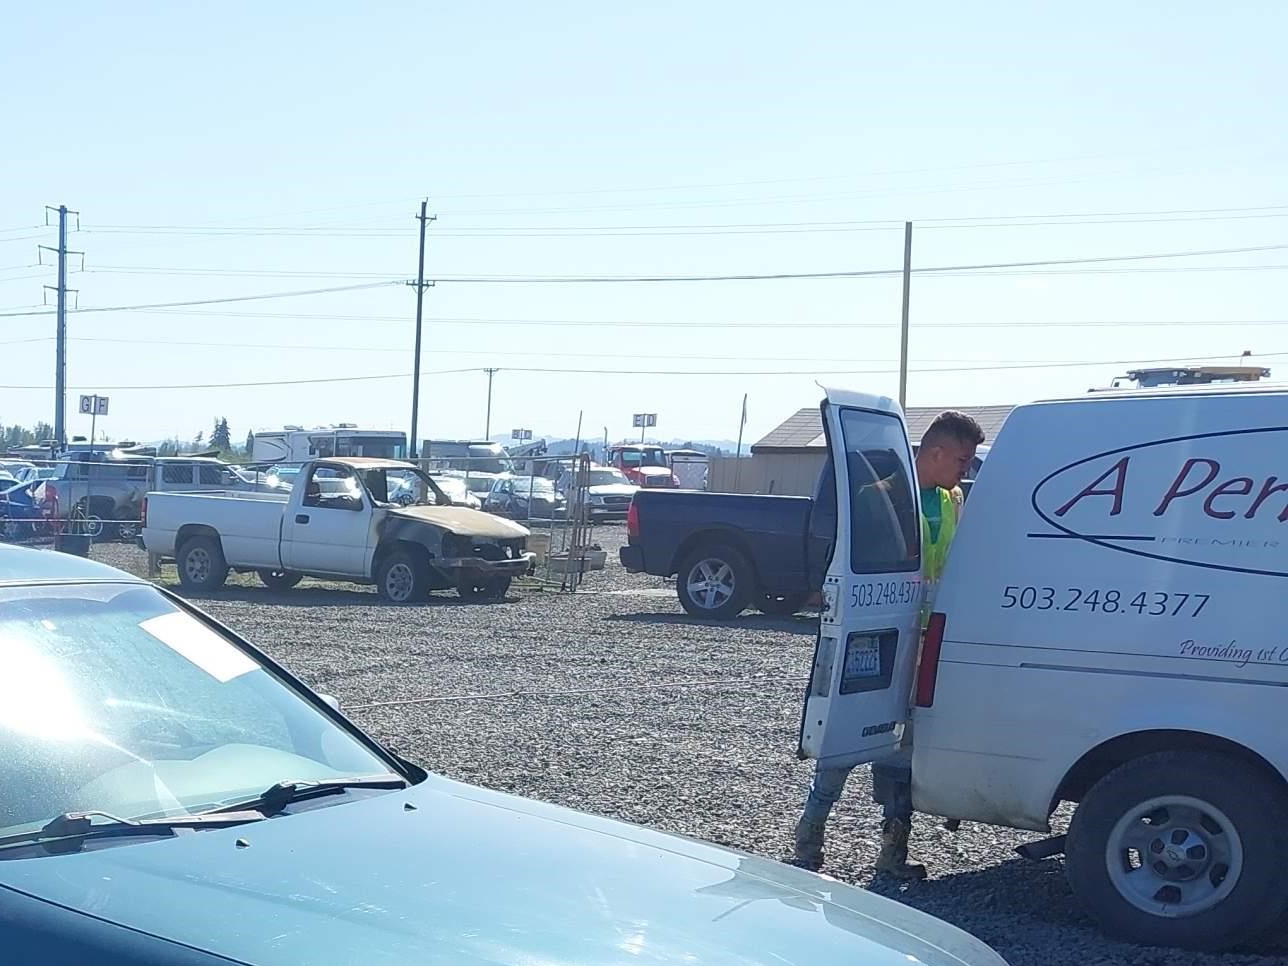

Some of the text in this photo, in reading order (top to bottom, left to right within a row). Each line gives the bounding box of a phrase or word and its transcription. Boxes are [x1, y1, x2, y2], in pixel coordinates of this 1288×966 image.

[1053, 456, 1288, 524] A Per
[851, 581, 921, 608] 503.248.4377
[1000, 586, 1210, 618] 503.248.4377
[1179, 639, 1253, 669] Providing
